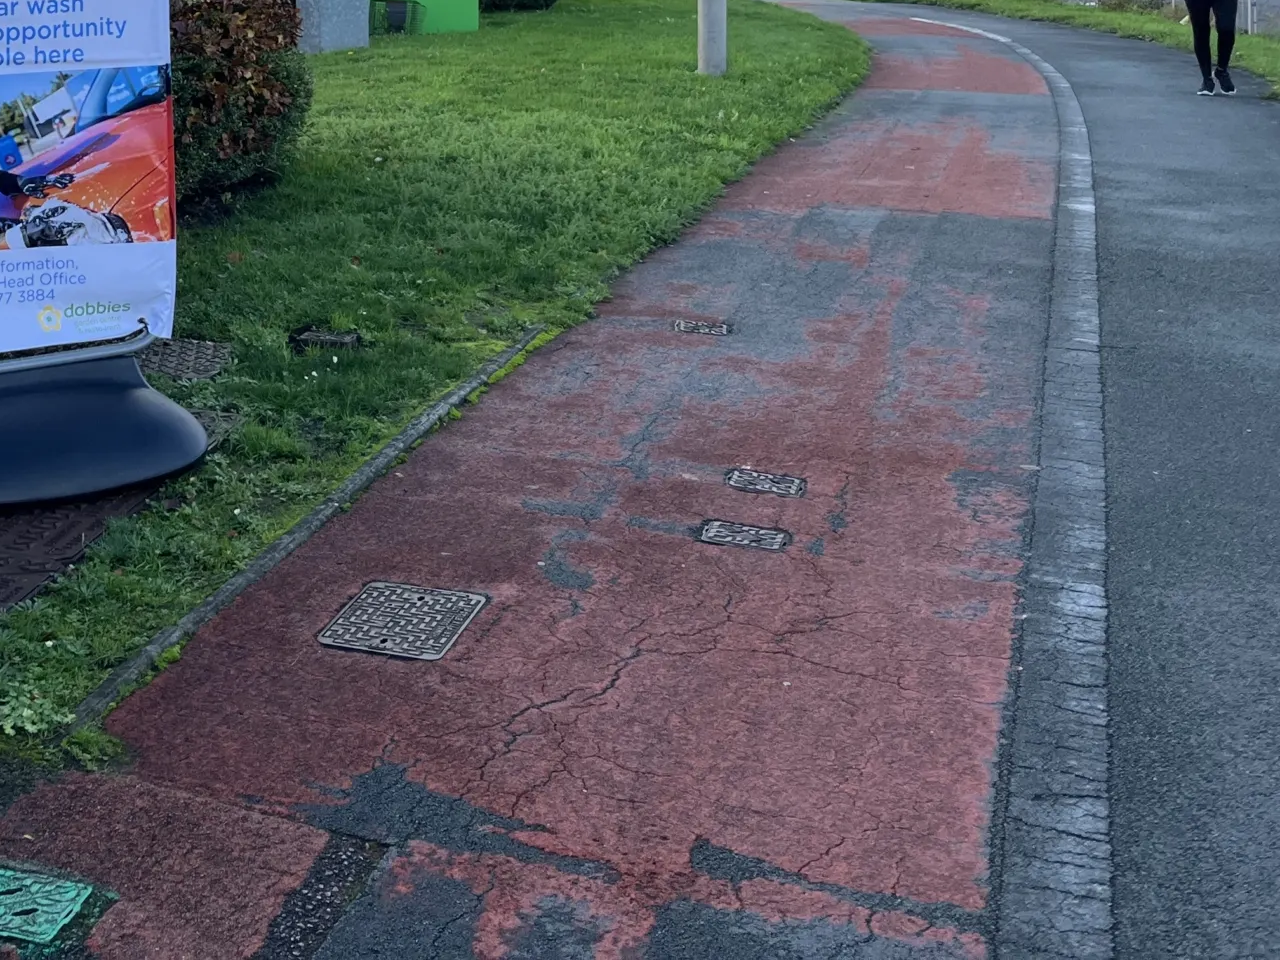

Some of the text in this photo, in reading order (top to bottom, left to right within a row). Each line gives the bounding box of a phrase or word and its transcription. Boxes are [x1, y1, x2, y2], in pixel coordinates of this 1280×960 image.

[34, 45, 84, 64] here
[39, 272, 87, 286] Office
[17, 289, 55, 303] 3884
[64, 301, 131, 318] dobbies
